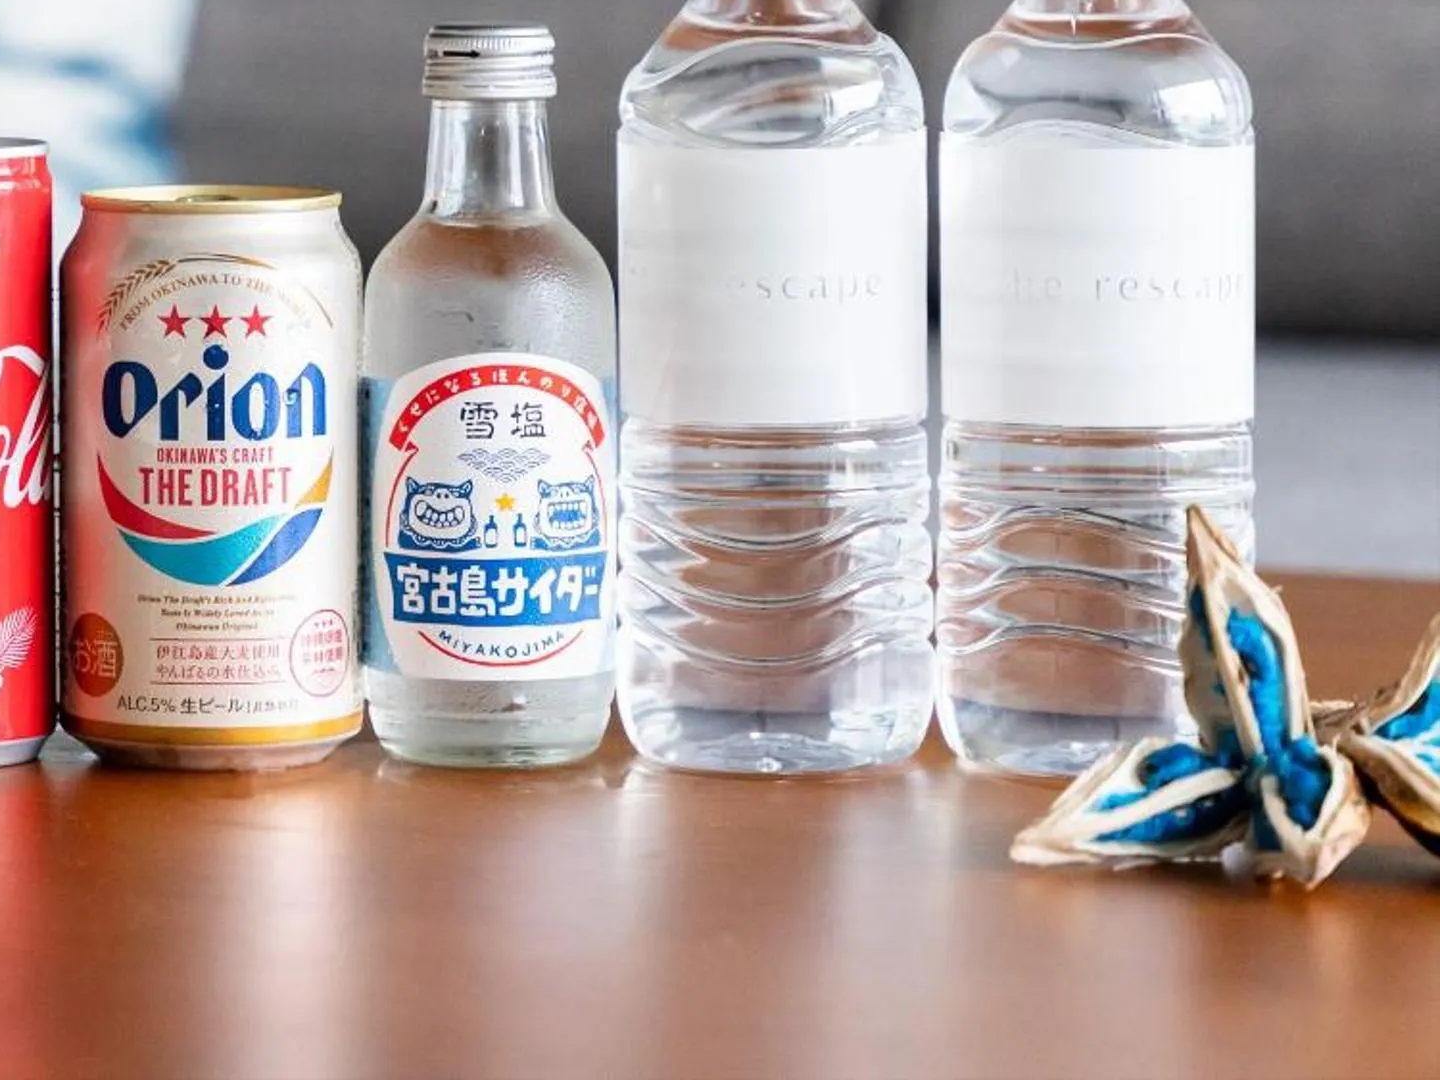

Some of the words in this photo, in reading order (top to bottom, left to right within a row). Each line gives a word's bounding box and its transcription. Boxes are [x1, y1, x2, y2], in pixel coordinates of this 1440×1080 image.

[152, 272, 218, 300] OKINAWA
[223, 272, 242, 286] TO
[460, 401, 546, 440] 雪塩
[157, 446, 228, 465] OKINAWA'S
[233, 446, 273, 464] CRAFT
[138, 467, 193, 507] THE
[201, 467, 292, 507] DRAFT
[397, 564, 598, 618] 宮古島サイダー
[438, 628, 566, 659] MIYAKOJIMA
[117, 695, 177, 714] ALC.5%
